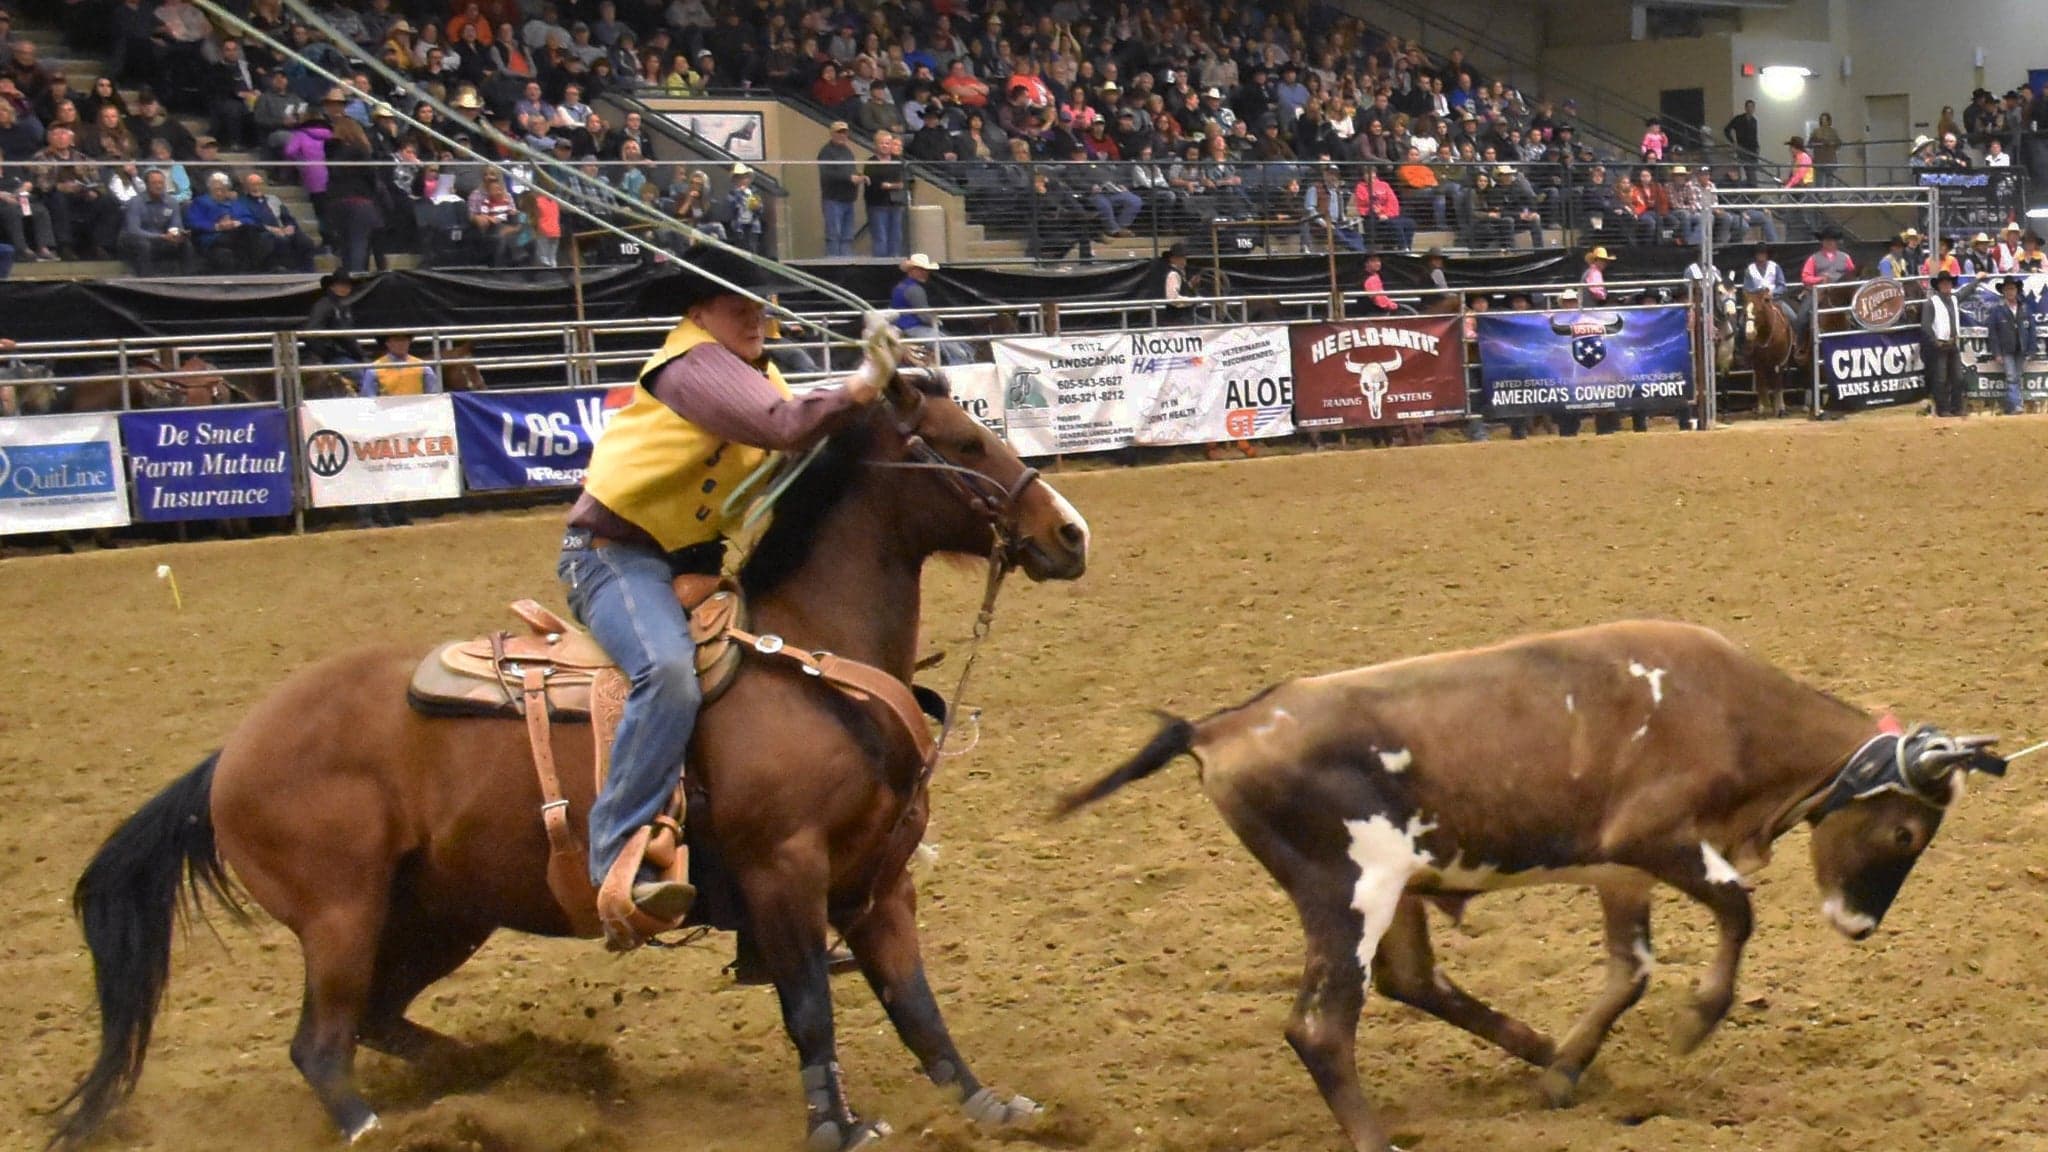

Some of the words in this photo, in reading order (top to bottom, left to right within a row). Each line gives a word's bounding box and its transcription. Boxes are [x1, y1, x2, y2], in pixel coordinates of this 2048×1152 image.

[620, 243, 640, 255] 105
[1071, 343, 1104, 353] FRITZ
[1131, 334, 1203, 355] Maxum
[1049, 354, 1126, 369] LANDSCAPING
[1831, 342, 1925, 379] CINCH
[1225, 376, 1291, 409] ALOE
[1492, 386, 1569, 406] AMERICA'S
[1575, 383, 1635, 401] COWBOY
[1641, 380, 1686, 398] SPORT
[1524, 379, 1556, 387] STATES
[1837, 381, 1870, 400] JEANS
[1872, 381, 1880, 393] &
[1881, 375, 1926, 392] SHIRTS
[2027, 377, 2043, 389] of
[1323, 397, 1362, 409] TRAINING
[1386, 391, 1433, 403] SYSTEMS
[1168, 407, 1196, 419] HEALTH
[156, 423, 190, 447] De
[195, 422, 256, 445] Smet
[501, 411, 578, 457] LAS
[352, 435, 454, 461] WALKER
[131, 456, 194, 479] Farm
[200, 451, 287, 476] Mutual
[12, 465, 107, 495] QuitLine
[151, 486, 270, 509] Insurance
